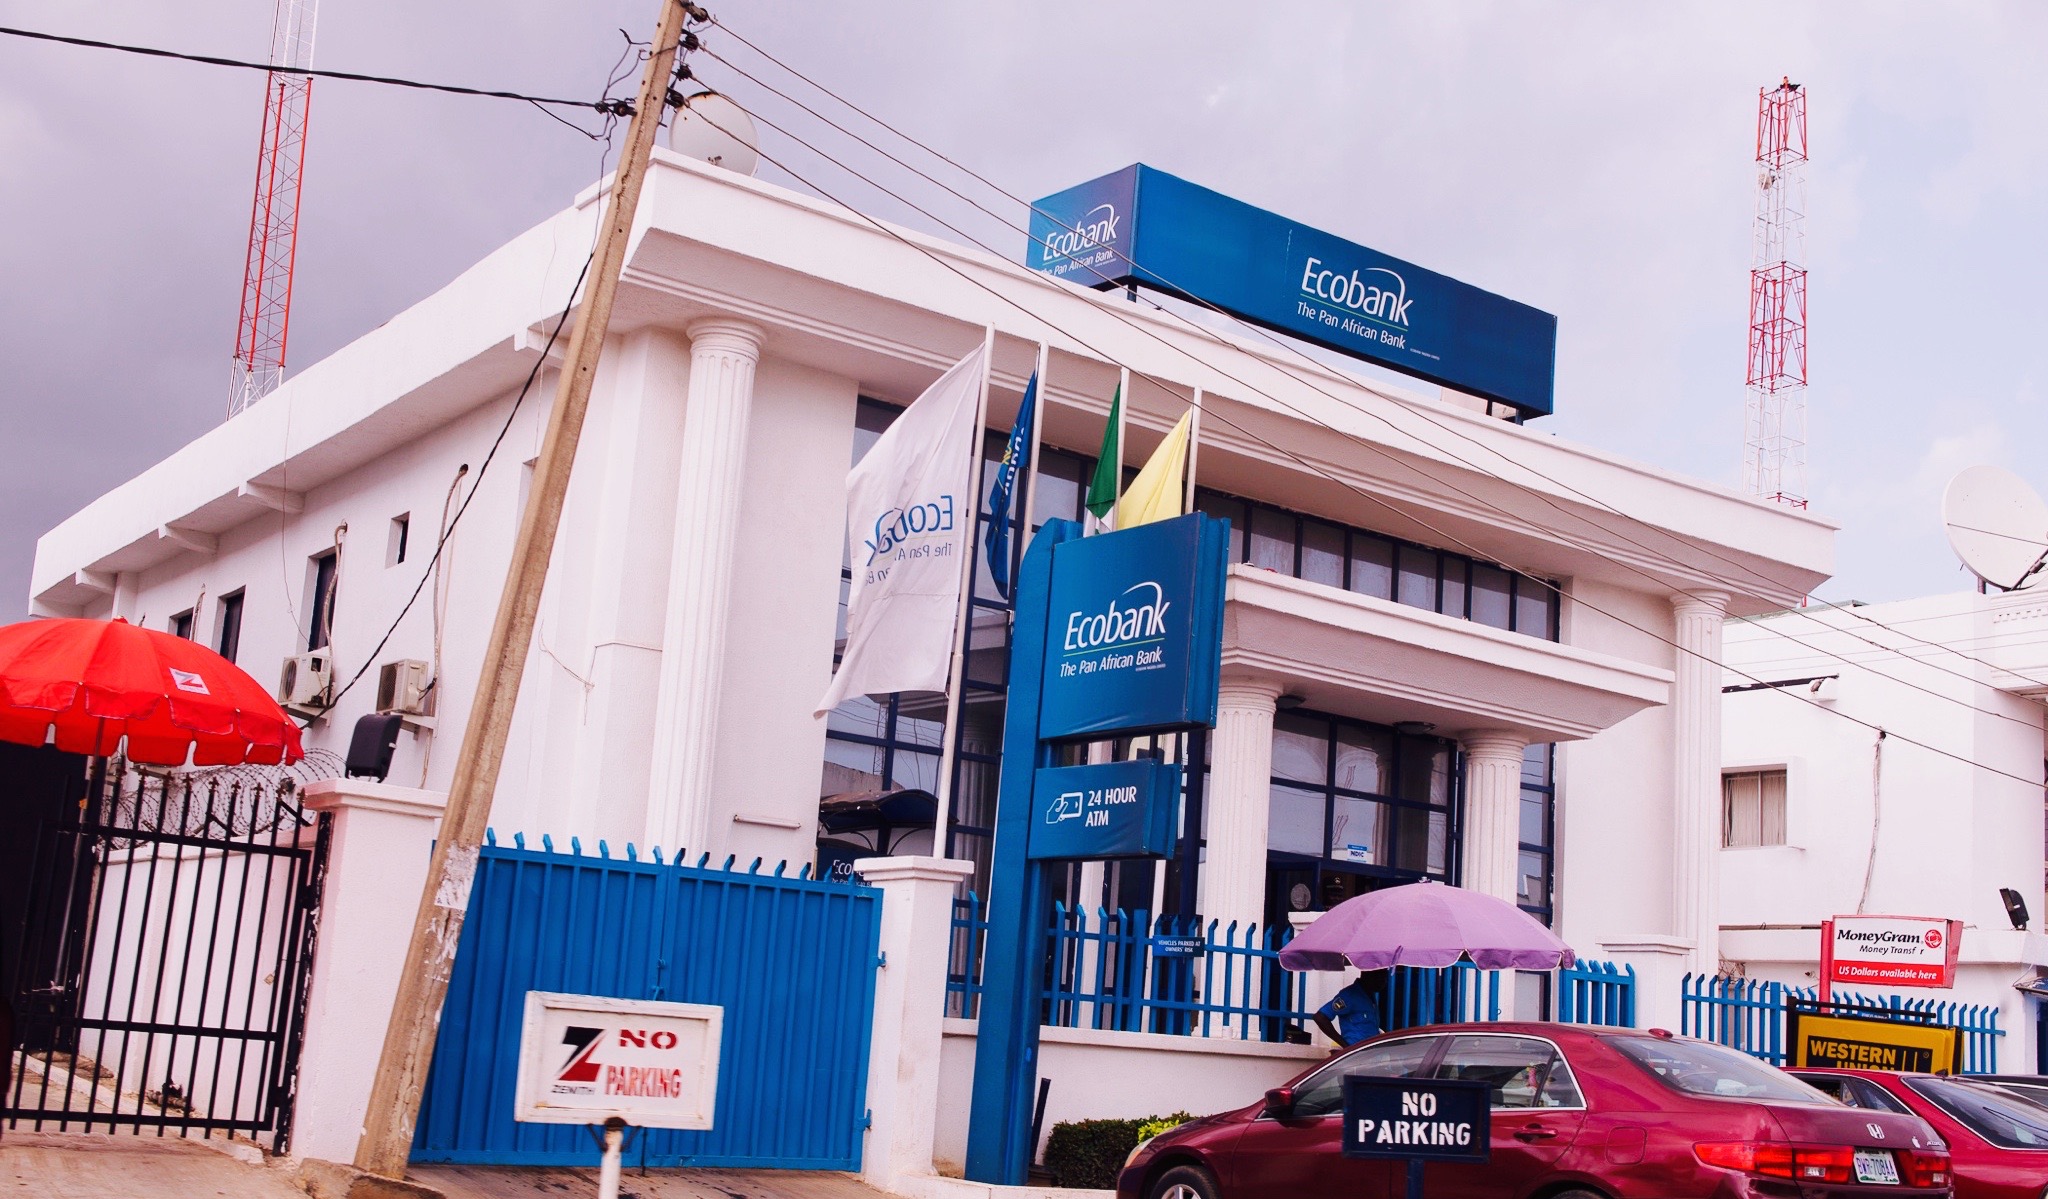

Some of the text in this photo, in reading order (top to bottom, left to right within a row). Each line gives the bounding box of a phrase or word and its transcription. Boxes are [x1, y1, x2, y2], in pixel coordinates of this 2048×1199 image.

[1043, 204, 1120, 261] Ecobank
[1054, 264, 1067, 275] Pan
[1069, 257, 1094, 272] African
[1095, 247, 1113, 263] Bank
[1302, 257, 1413, 326] Ecobank
[1297, 301, 1406, 350] The Pan African Bank
[1064, 581, 1170, 651] Ecobank
[1060, 661, 1076, 678] The
[1079, 659, 1097, 675] Pan
[1099, 653, 1133, 671] African
[1135, 646, 1162, 666] Bank
[1087, 786, 1137, 807] 24 HOUR
[1085, 809, 1109, 828] ATM
[1837, 929, 1920, 945] MoneyGram
[1860, 944, 1889, 956] Money
[1838, 965, 1937, 980] US Dollars available here
[619, 1028, 678, 1050] NO
[1810, 1040, 1897, 1065] WESTERN
[551, 1084, 596, 1096] ZENITH
[605, 1065, 682, 1099] PARKING
[1402, 1091, 1437, 1117] NO
[1358, 1118, 1471, 1146] PARKING
